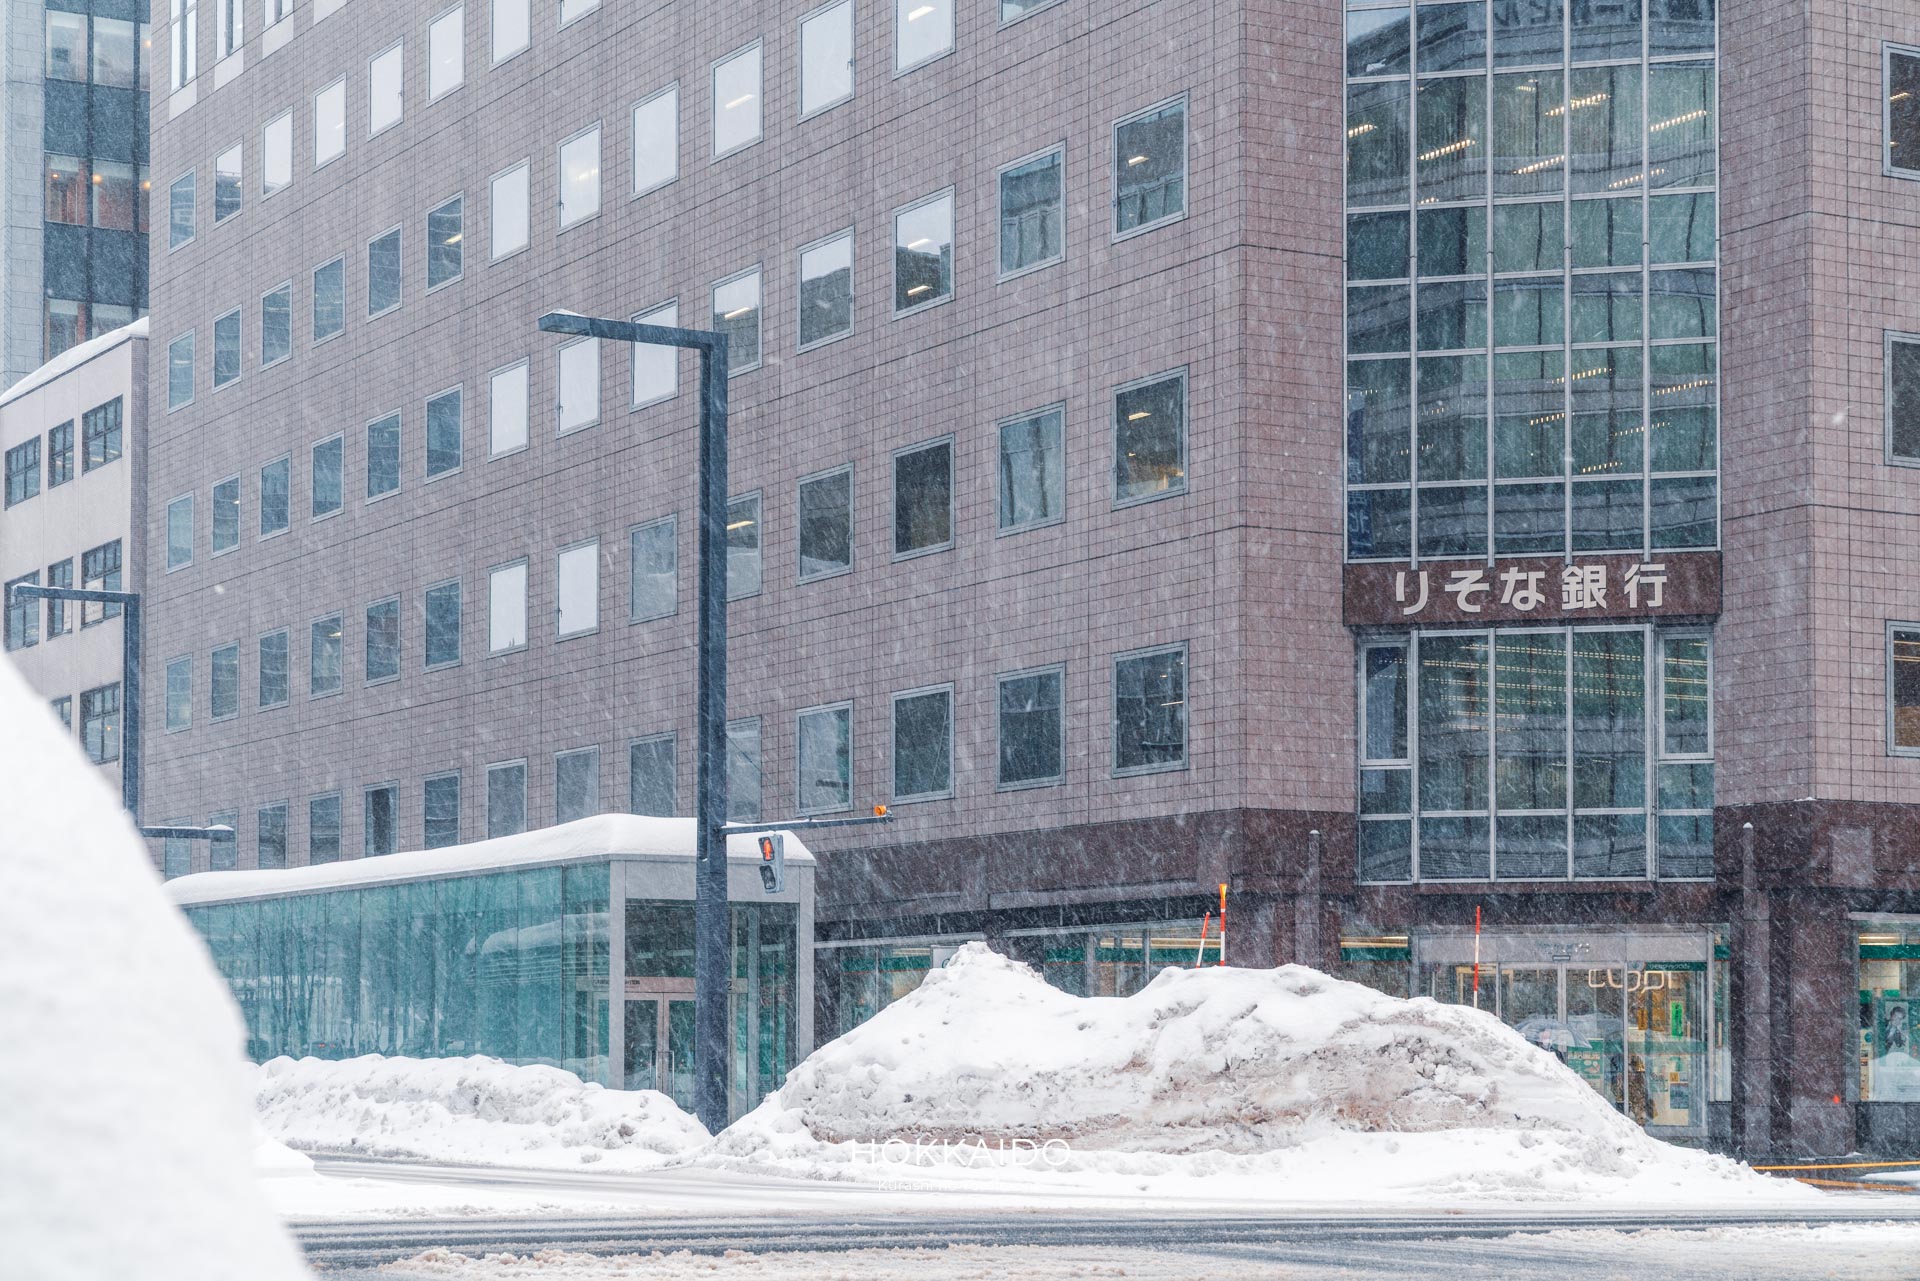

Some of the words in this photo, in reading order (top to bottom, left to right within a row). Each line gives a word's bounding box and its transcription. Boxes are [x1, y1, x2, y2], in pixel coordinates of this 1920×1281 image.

[1395, 563, 1667, 615] りそな銀行
